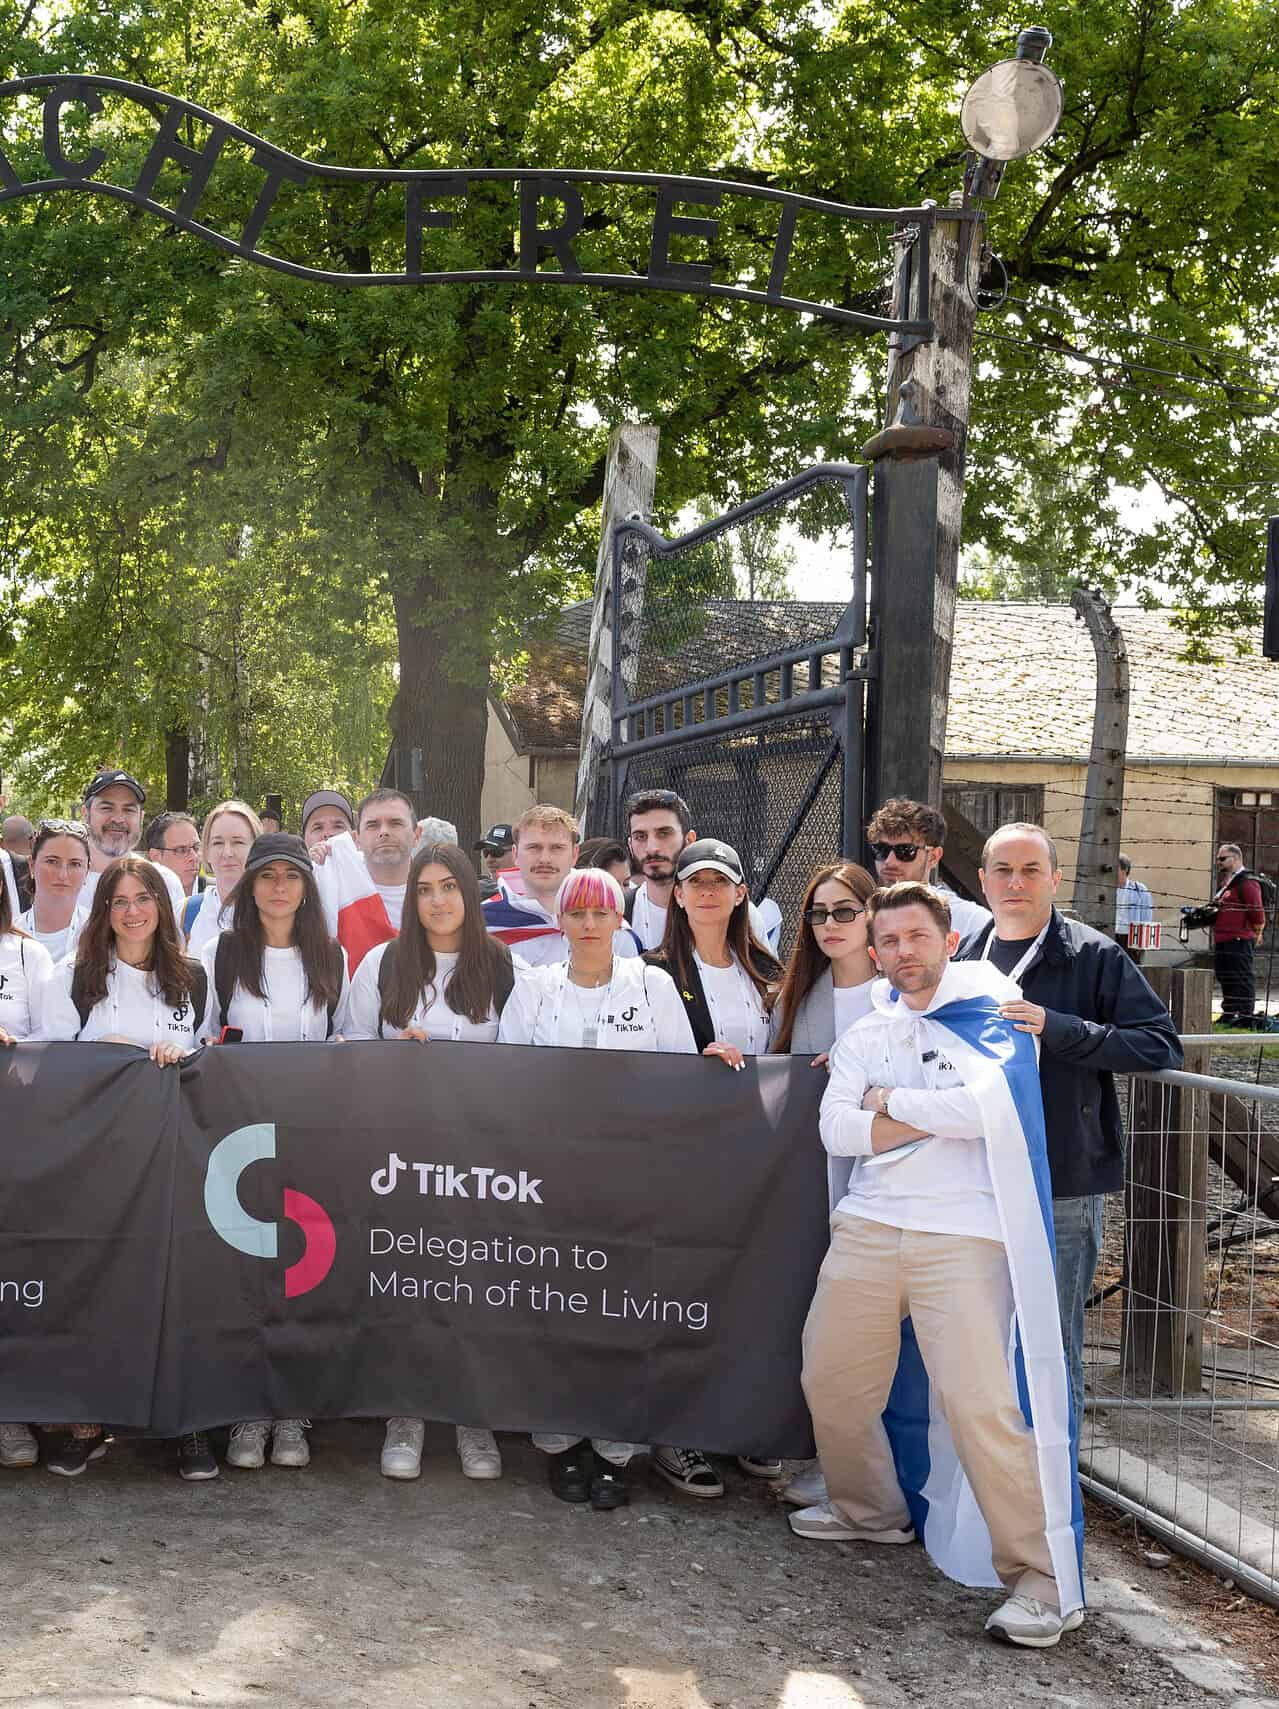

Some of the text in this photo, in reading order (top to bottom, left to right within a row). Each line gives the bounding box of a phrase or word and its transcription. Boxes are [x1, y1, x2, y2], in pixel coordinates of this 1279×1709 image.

[406, 178, 800, 298] FREI
[615, 1023, 645, 1032] TikTok
[413, 1162, 544, 1204] TikTok
[369, 1227, 608, 1271] Delegation to
[368, 1271, 711, 1329] March of the Living
